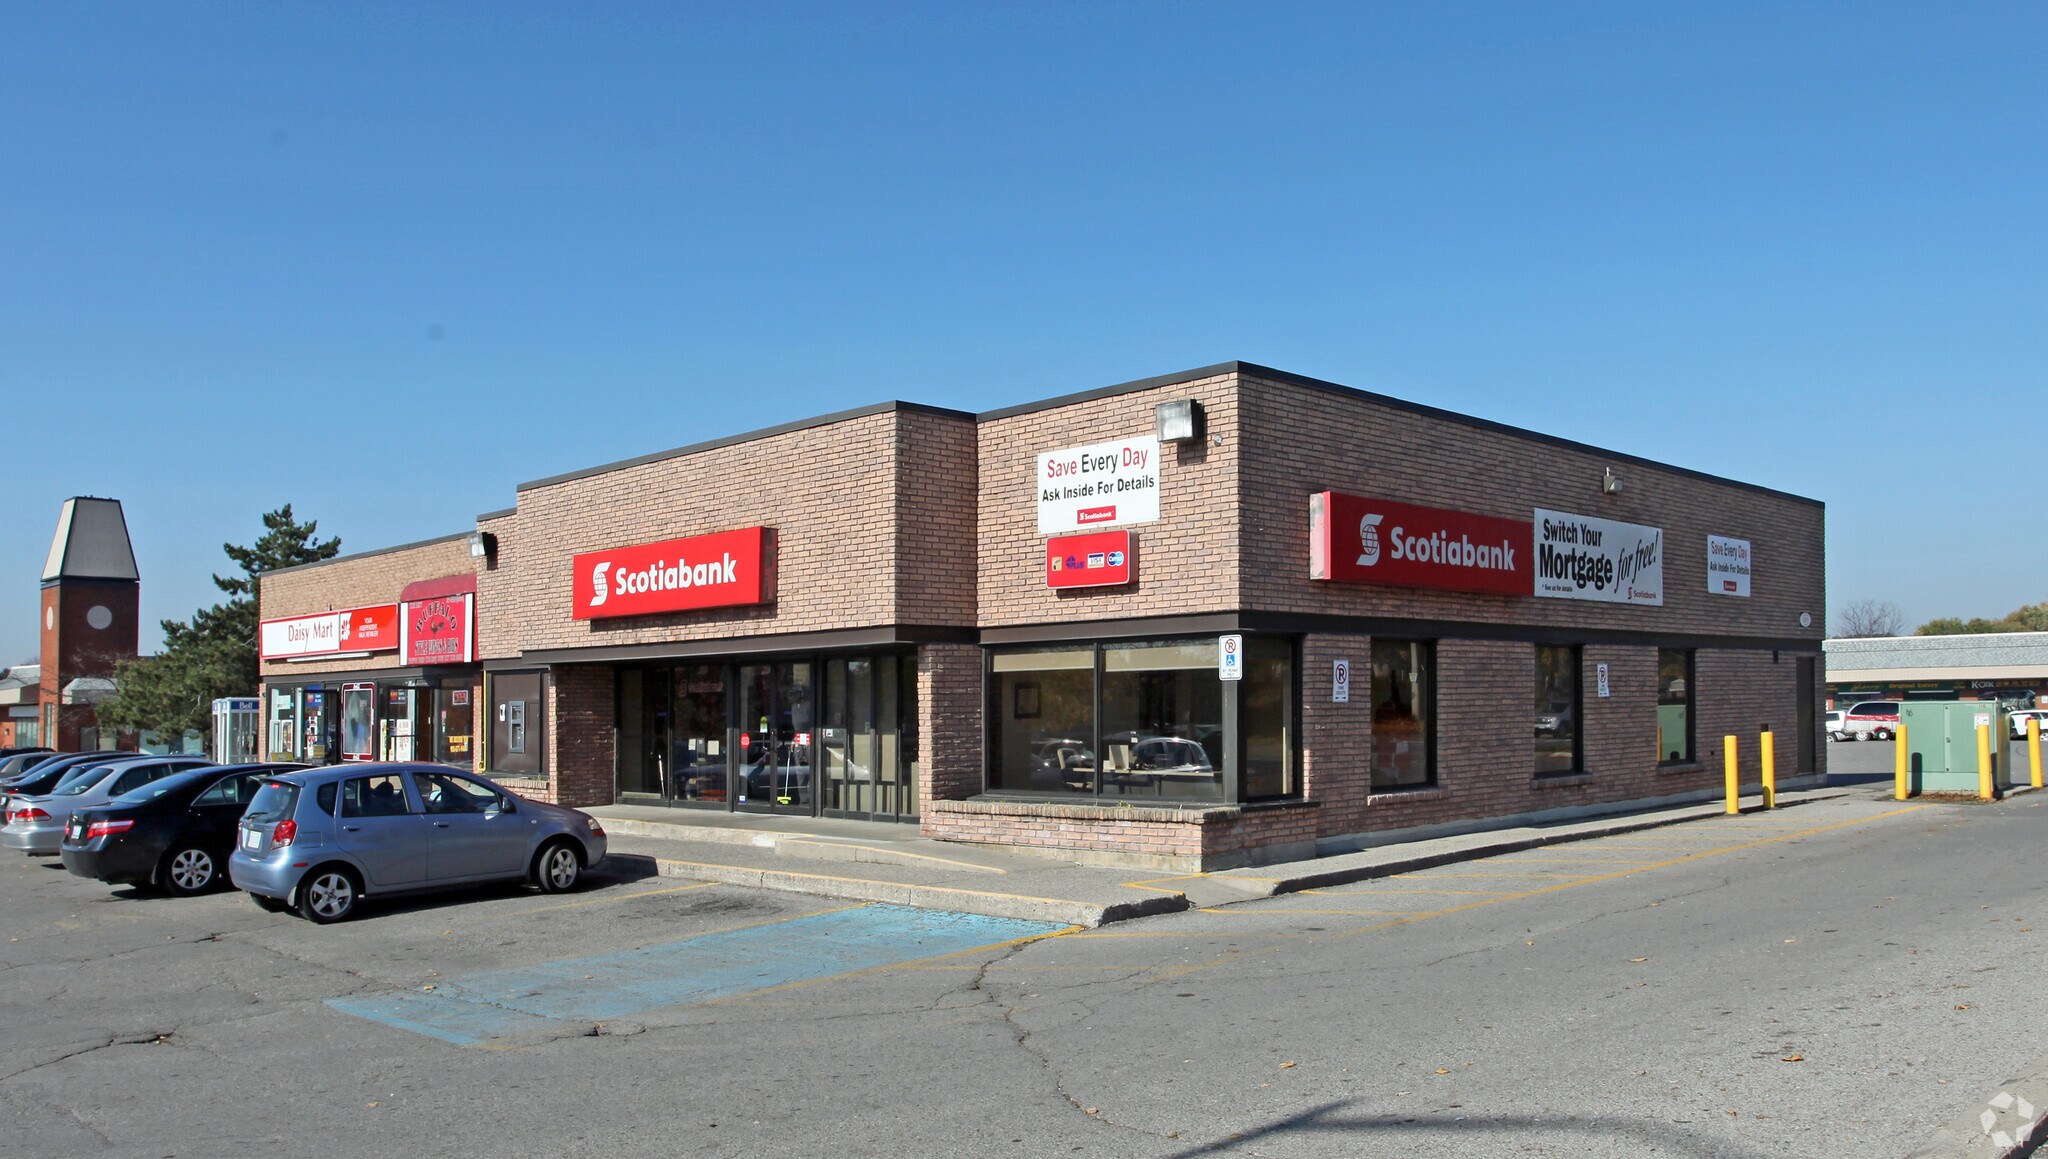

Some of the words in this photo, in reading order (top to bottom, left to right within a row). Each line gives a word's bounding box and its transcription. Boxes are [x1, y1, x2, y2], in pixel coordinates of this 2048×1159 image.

[1047, 459, 1077, 479] Save
[1081, 453, 1118, 474] Every
[1123, 446, 1148, 470] Day
[1042, 487, 1061, 502] Ask
[1063, 484, 1094, 499] Inside
[1097, 481, 1114, 495] For
[1117, 474, 1155, 492] Details
[1084, 510, 1113, 521] Scotiabank
[1543, 518, 1578, 545] Switch
[1580, 523, 1603, 547] Your
[1390, 526, 1516, 571] Scotiabank
[1613, 547, 1633, 594] for
[1631, 530, 1660, 584] free!
[1711, 540, 1724, 556] Save
[1724, 542, 1738, 561] Every
[1738, 544, 1748, 562] Day
[615, 552, 738, 596] Scotiabank
[1539, 543, 1613, 591] Mortgage
[1709, 561, 1718, 571] Ask
[1718, 562, 1729, 573] Inside
[1736, 565, 1750, 576] Details
[1633, 589, 1657, 600] Scotiabank
[415, 600, 458, 634] BUFFALO
[287, 622, 310, 642] Daisy
[313, 621, 333, 639] Mart
[239, 701, 253, 710] Bell
